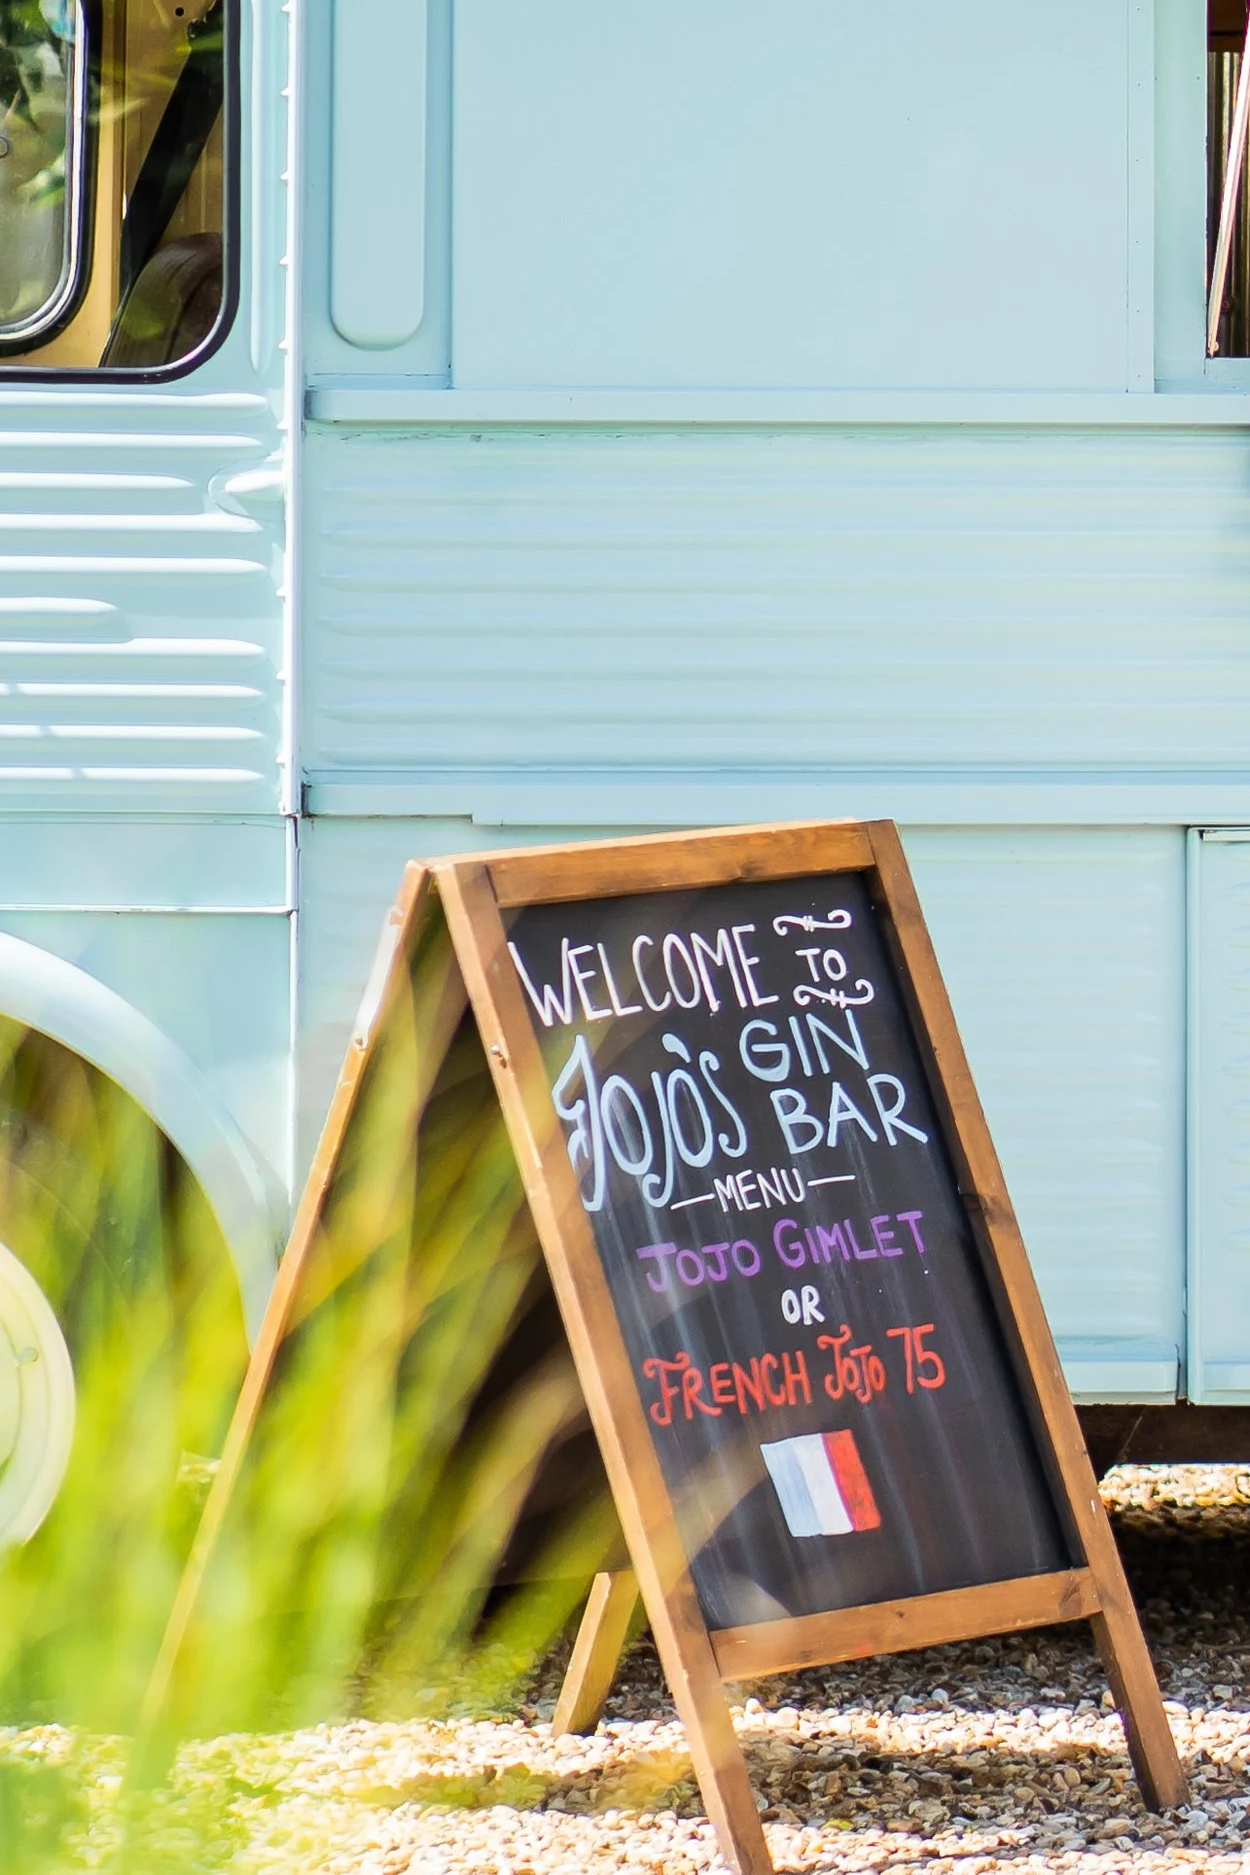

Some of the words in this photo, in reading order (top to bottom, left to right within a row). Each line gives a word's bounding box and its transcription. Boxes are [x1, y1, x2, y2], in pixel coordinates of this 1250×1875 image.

[507, 924, 779, 1027] WELCOME
[795, 948, 848, 983] TO
[738, 1008, 870, 1083] GIN
[769, 1073, 929, 1156] BAR
[636, 1238, 762, 1293] JOJO
[773, 1210, 927, 1269] GIMLET
[781, 1284, 826, 1325] OR
[642, 1349, 813, 1427] FRENCH
[886, 1323, 946, 1395] 75
